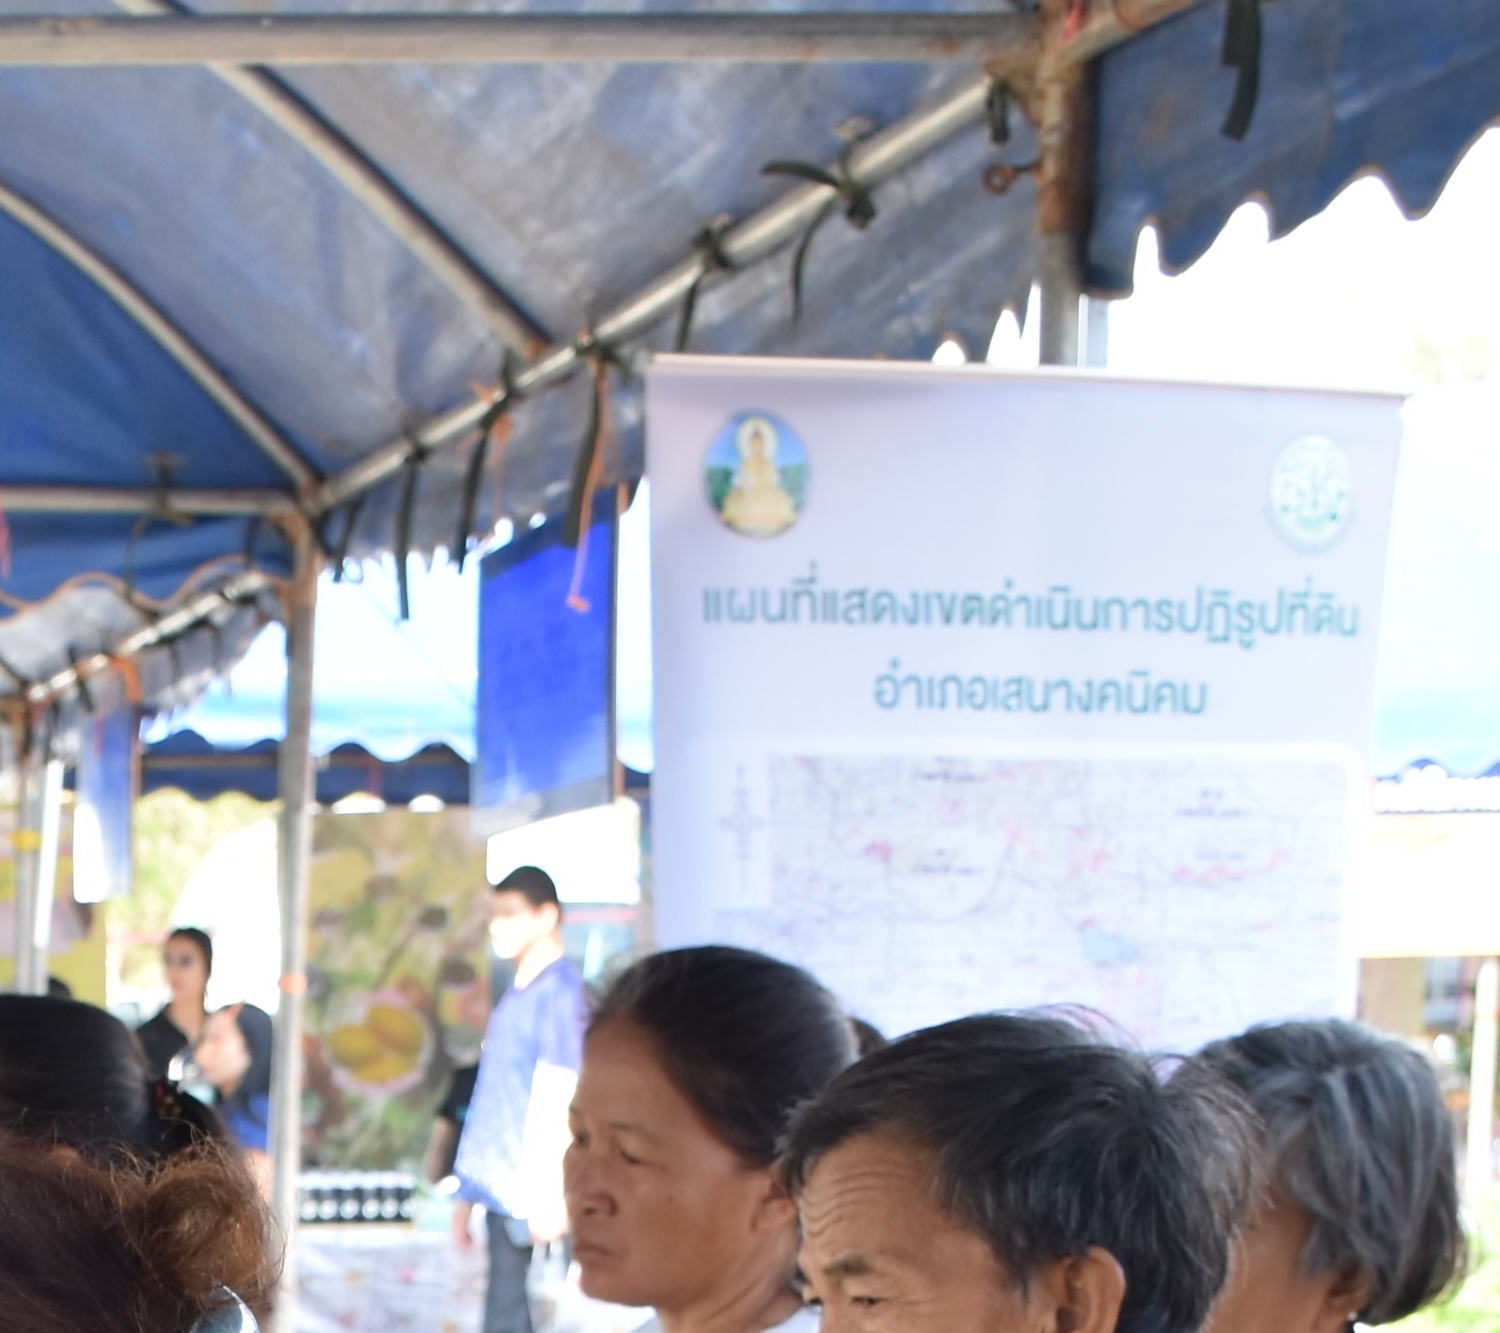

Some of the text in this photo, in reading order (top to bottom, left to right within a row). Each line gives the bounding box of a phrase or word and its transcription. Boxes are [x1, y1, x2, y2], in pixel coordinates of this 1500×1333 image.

[702, 564, 1361, 650] แผนที่แสดงเขตดำเนินการปฏิรูปที่ดิน
[874, 658, 1208, 715] อำเภอเสนางคนิคม
